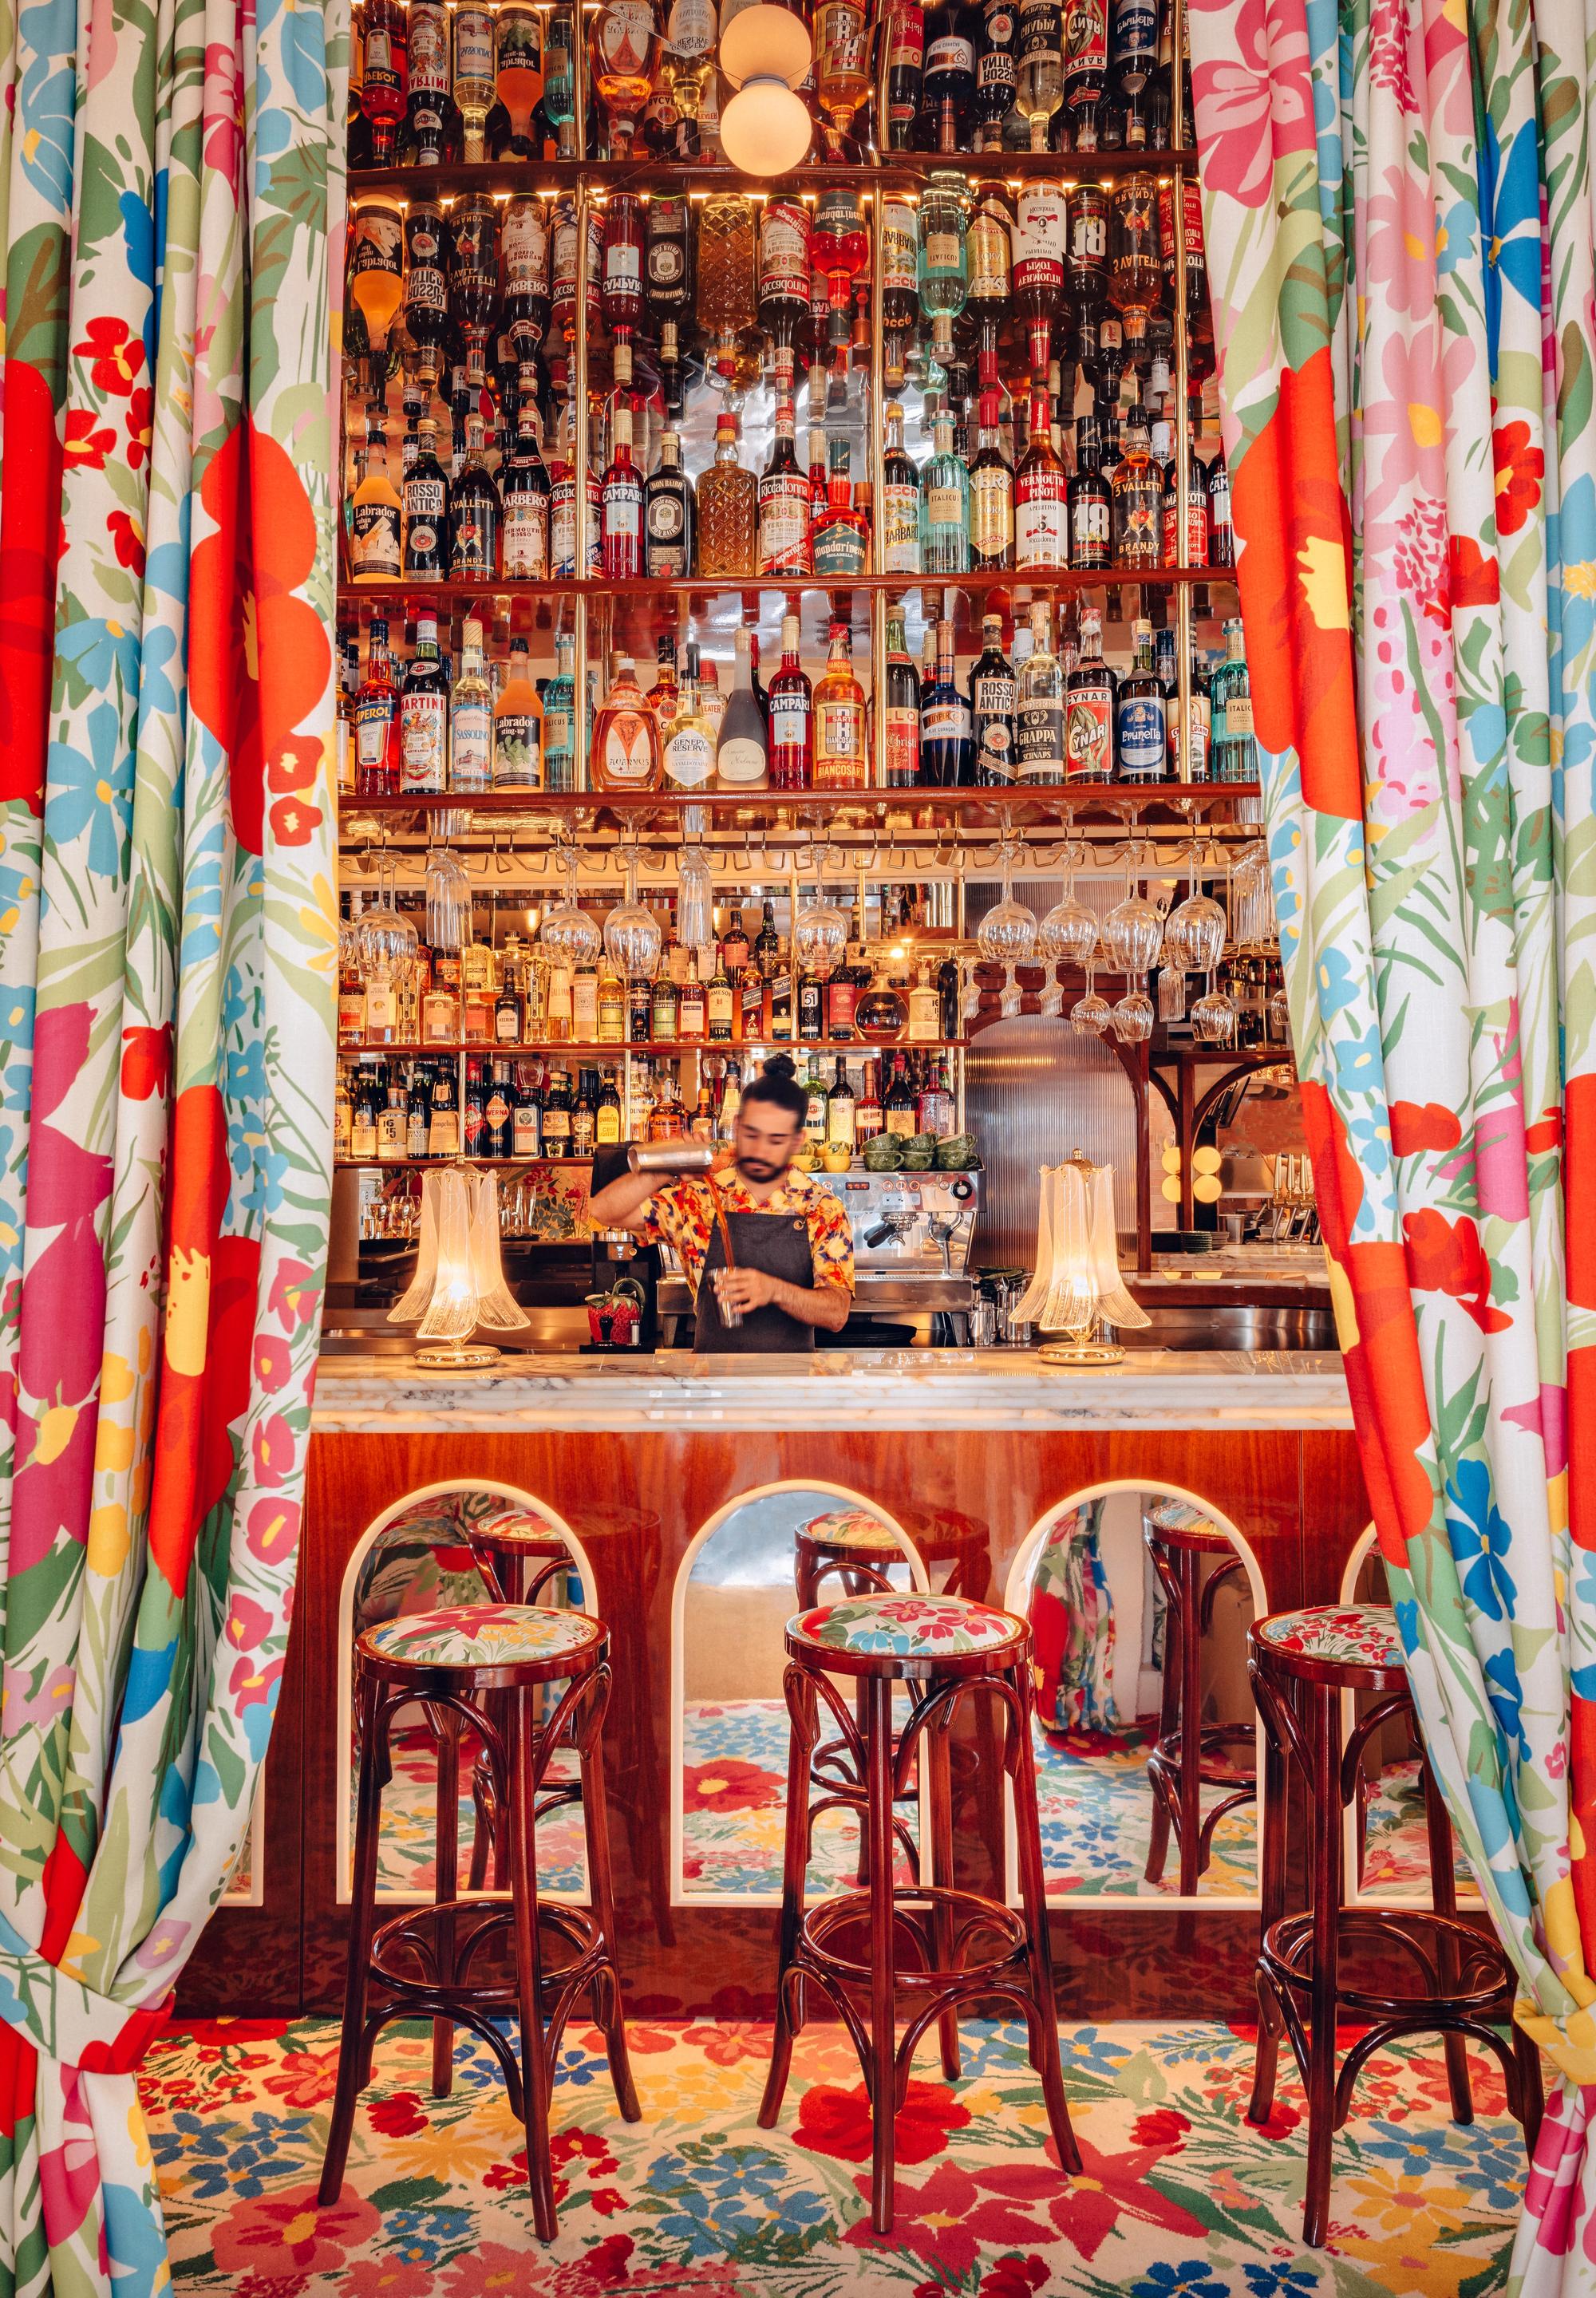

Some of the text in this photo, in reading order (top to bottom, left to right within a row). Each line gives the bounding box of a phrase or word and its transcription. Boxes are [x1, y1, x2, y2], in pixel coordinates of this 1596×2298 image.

[652, 480, 683, 489] DON BAIRO
[1021, 476, 1064, 488] VERMOUTH
[407, 484, 440, 499] ROSSO
[602, 488, 643, 503] CAMPARI
[760, 481, 808, 497] Riccadonna
[1115, 481, 1163, 498] 3 VALLETTI
[931, 494, 960, 503] ITALICUS
[452, 499, 494, 512] VALLETTI
[355, 506, 397, 519] Labrador
[1073, 503, 1110, 542] 18
[978, 535, 1006, 548] NATURALE
[1029, 535, 1057, 544] Riccadonna
[775, 541, 808, 566] aperitivo
[1119, 542, 1161, 554] BRANDY
[452, 557, 484, 567] BRANDY
[981, 681, 1013, 696] ROSSO
[1068, 691, 1108, 705] CYNAR
[769, 698, 810, 713] CAMPARI
[357, 707, 391, 724] APEROL
[496, 716, 535, 730] Labrador
[456, 728, 489, 741] SASSOLINO
[1019, 729, 1057, 746] GRAPPA
[1122, 728, 1161, 743] Prunella
[674, 738, 706, 747] GENEPY
[1070, 724, 1105, 759] CYNAR
[672, 745, 709, 755] RESERVE
[1022, 751, 1052, 760] SCHNAPS
[818, 764, 863, 777] BIANCOSARTI
[804, 993, 816, 1005] 51
[382, 1119, 394, 1127] 16
[385, 1127, 396, 1139] 15
